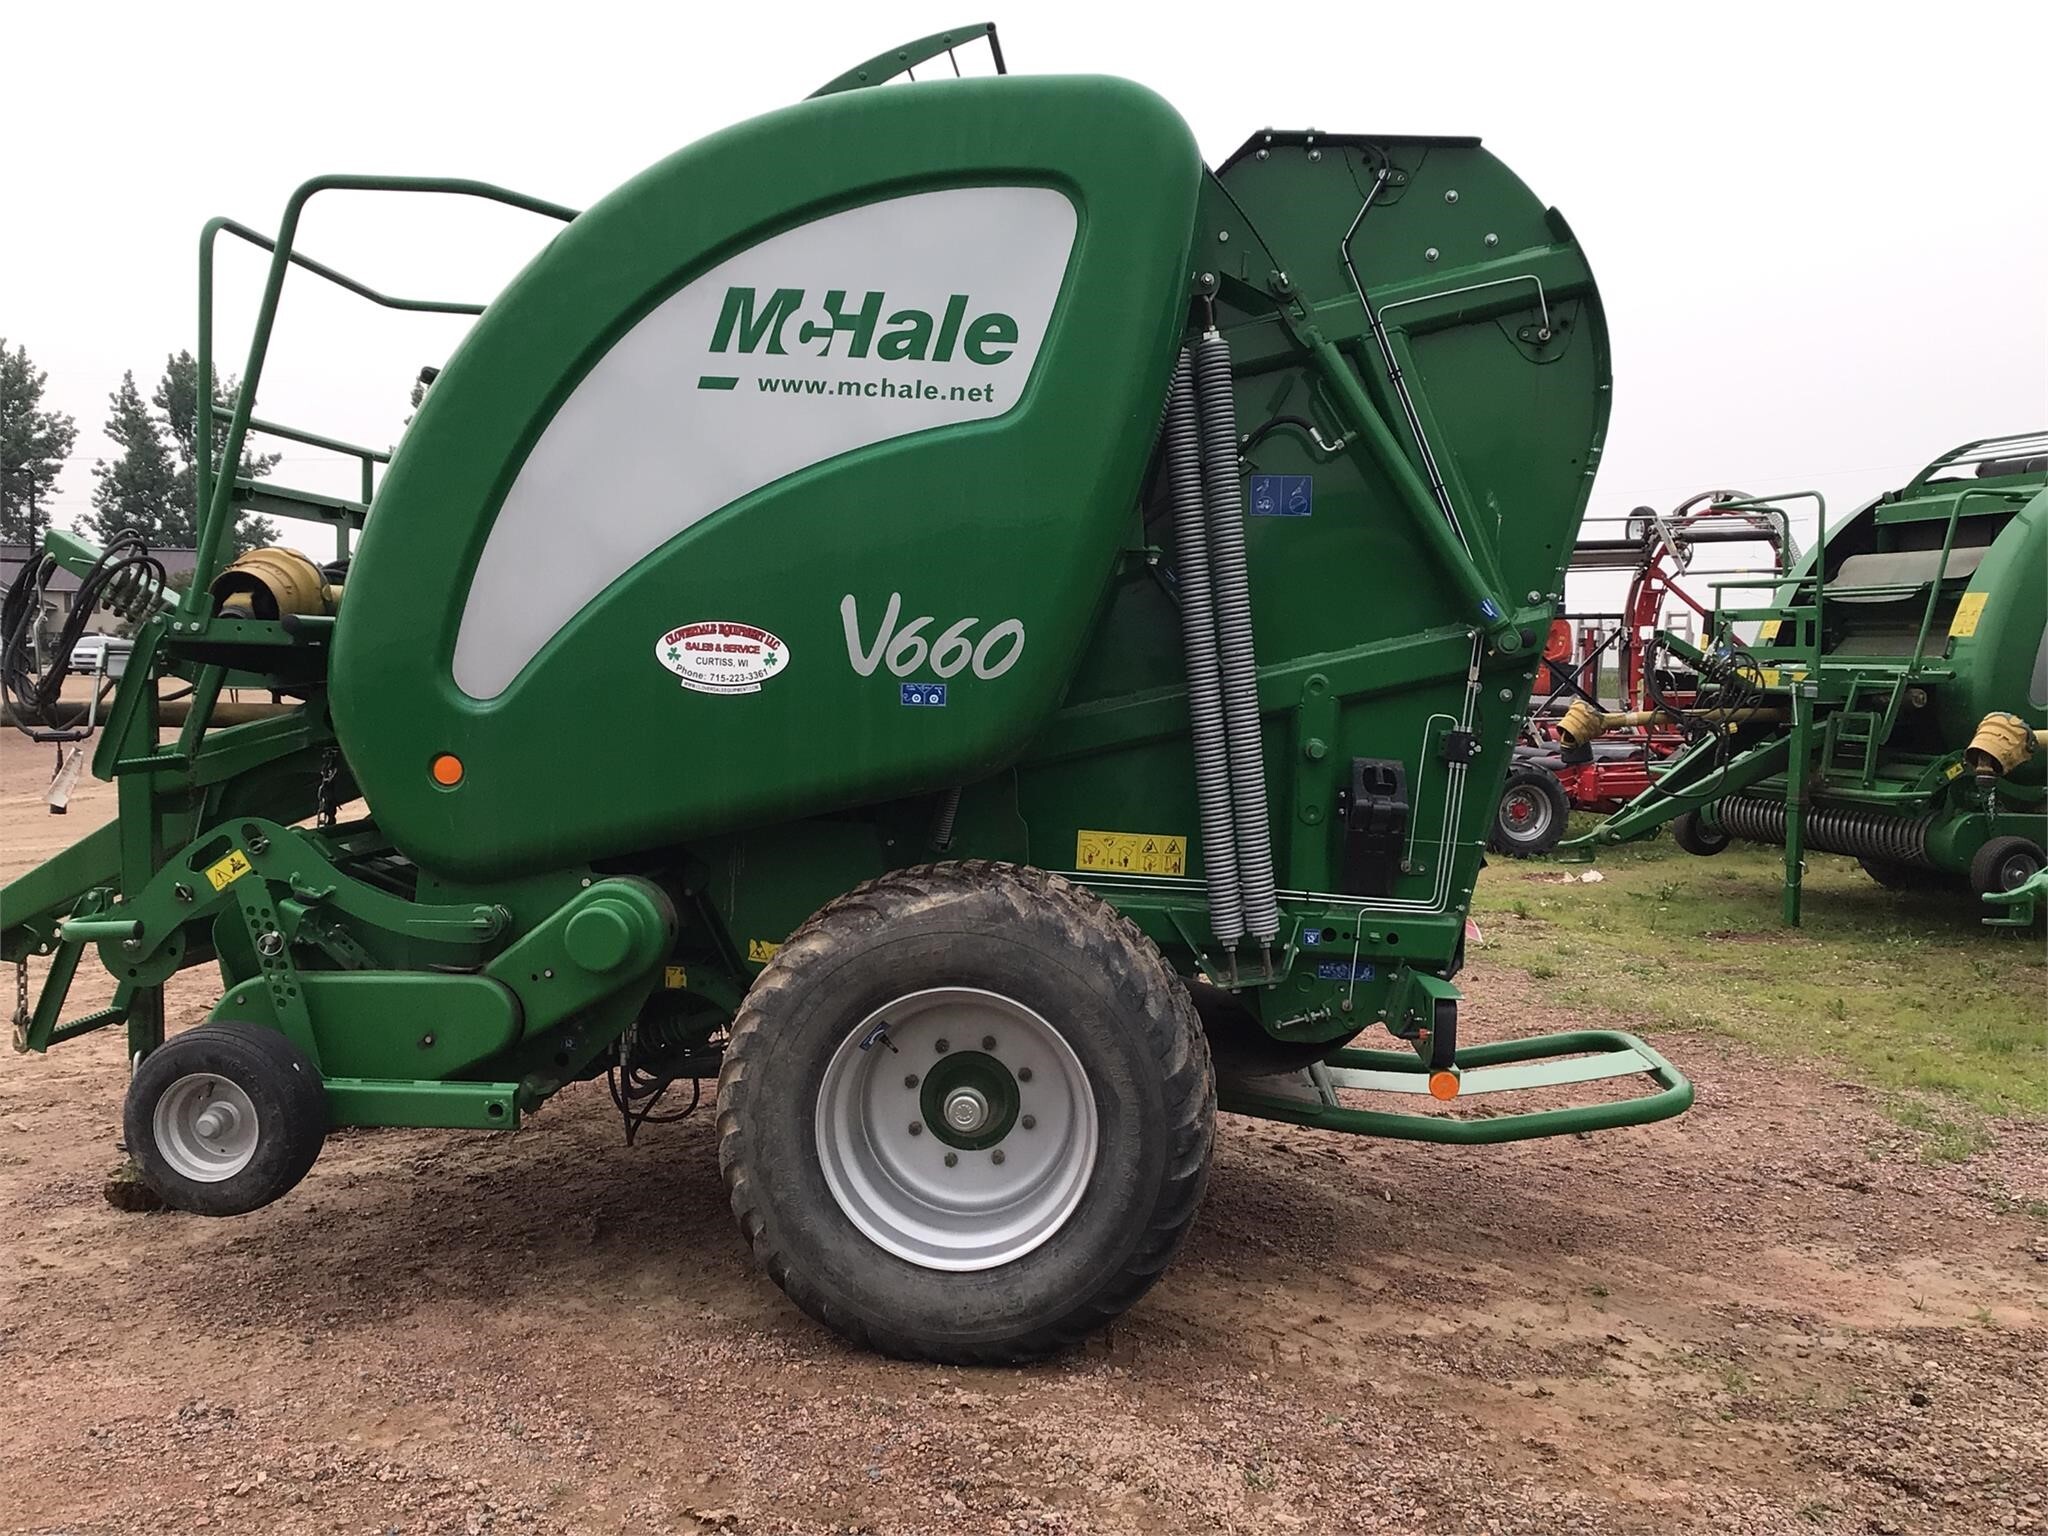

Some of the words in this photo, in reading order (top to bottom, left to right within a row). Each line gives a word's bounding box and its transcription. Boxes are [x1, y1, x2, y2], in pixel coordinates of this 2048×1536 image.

[709, 286, 1019, 366] McHale
[757, 377, 995, 403] www.mchale.net
[763, 634, 781, 651] LLC
[840, 592, 1026, 680] V660
[685, 641, 714, 652] SALES
[715, 643, 722, 652] &
[723, 643, 761, 655] SERVICE
[695, 656, 736, 668] CURTISS,
[738, 658, 749, 668] WI
[675, 664, 707, 680] Phone:
[709, 668, 769, 683] 715-223-3361
